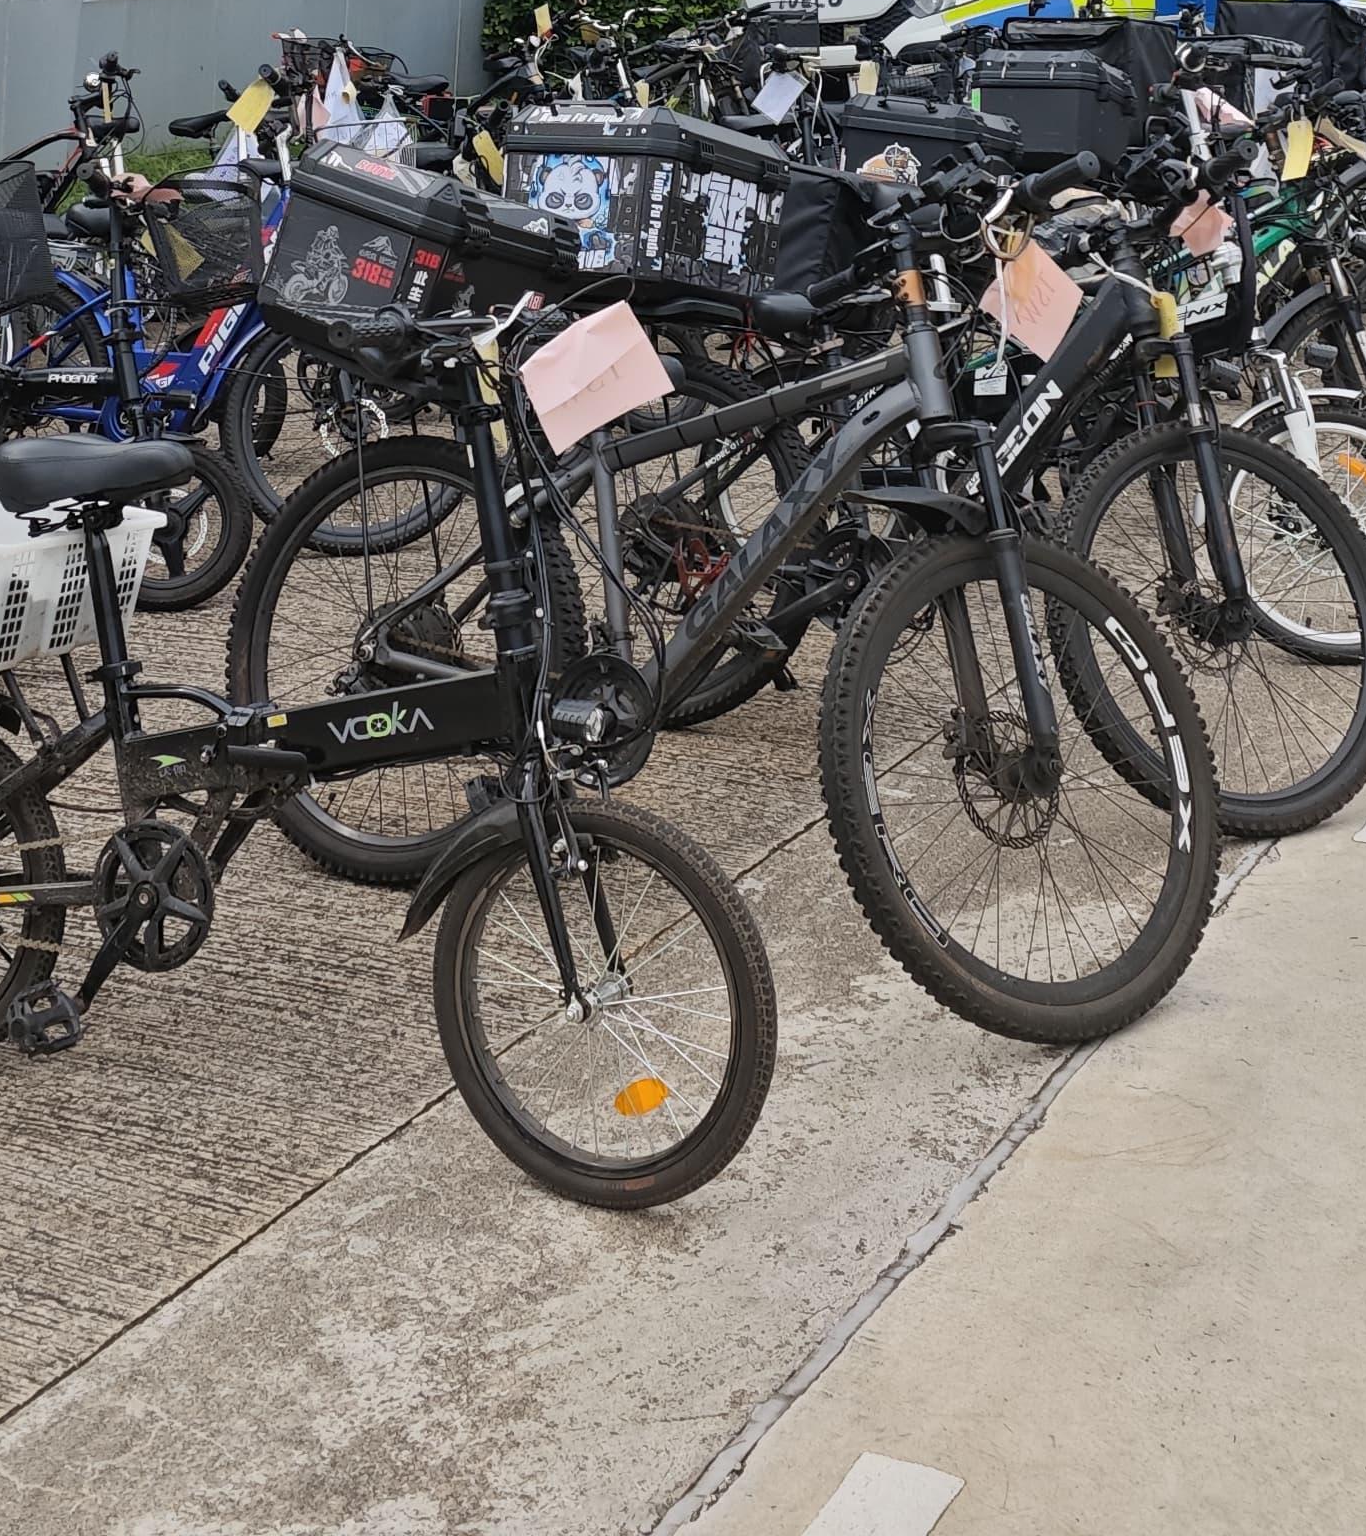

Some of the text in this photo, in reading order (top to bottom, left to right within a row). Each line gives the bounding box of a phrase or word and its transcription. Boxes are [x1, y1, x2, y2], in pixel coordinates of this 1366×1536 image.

[645, 170, 667, 258] Kung Fu Panda
[351, 257, 382, 285] 318
[414, 248, 442, 270] 318
[685, 432, 842, 641] GALAXY
[1019, 593, 1051, 694] GALAXY
